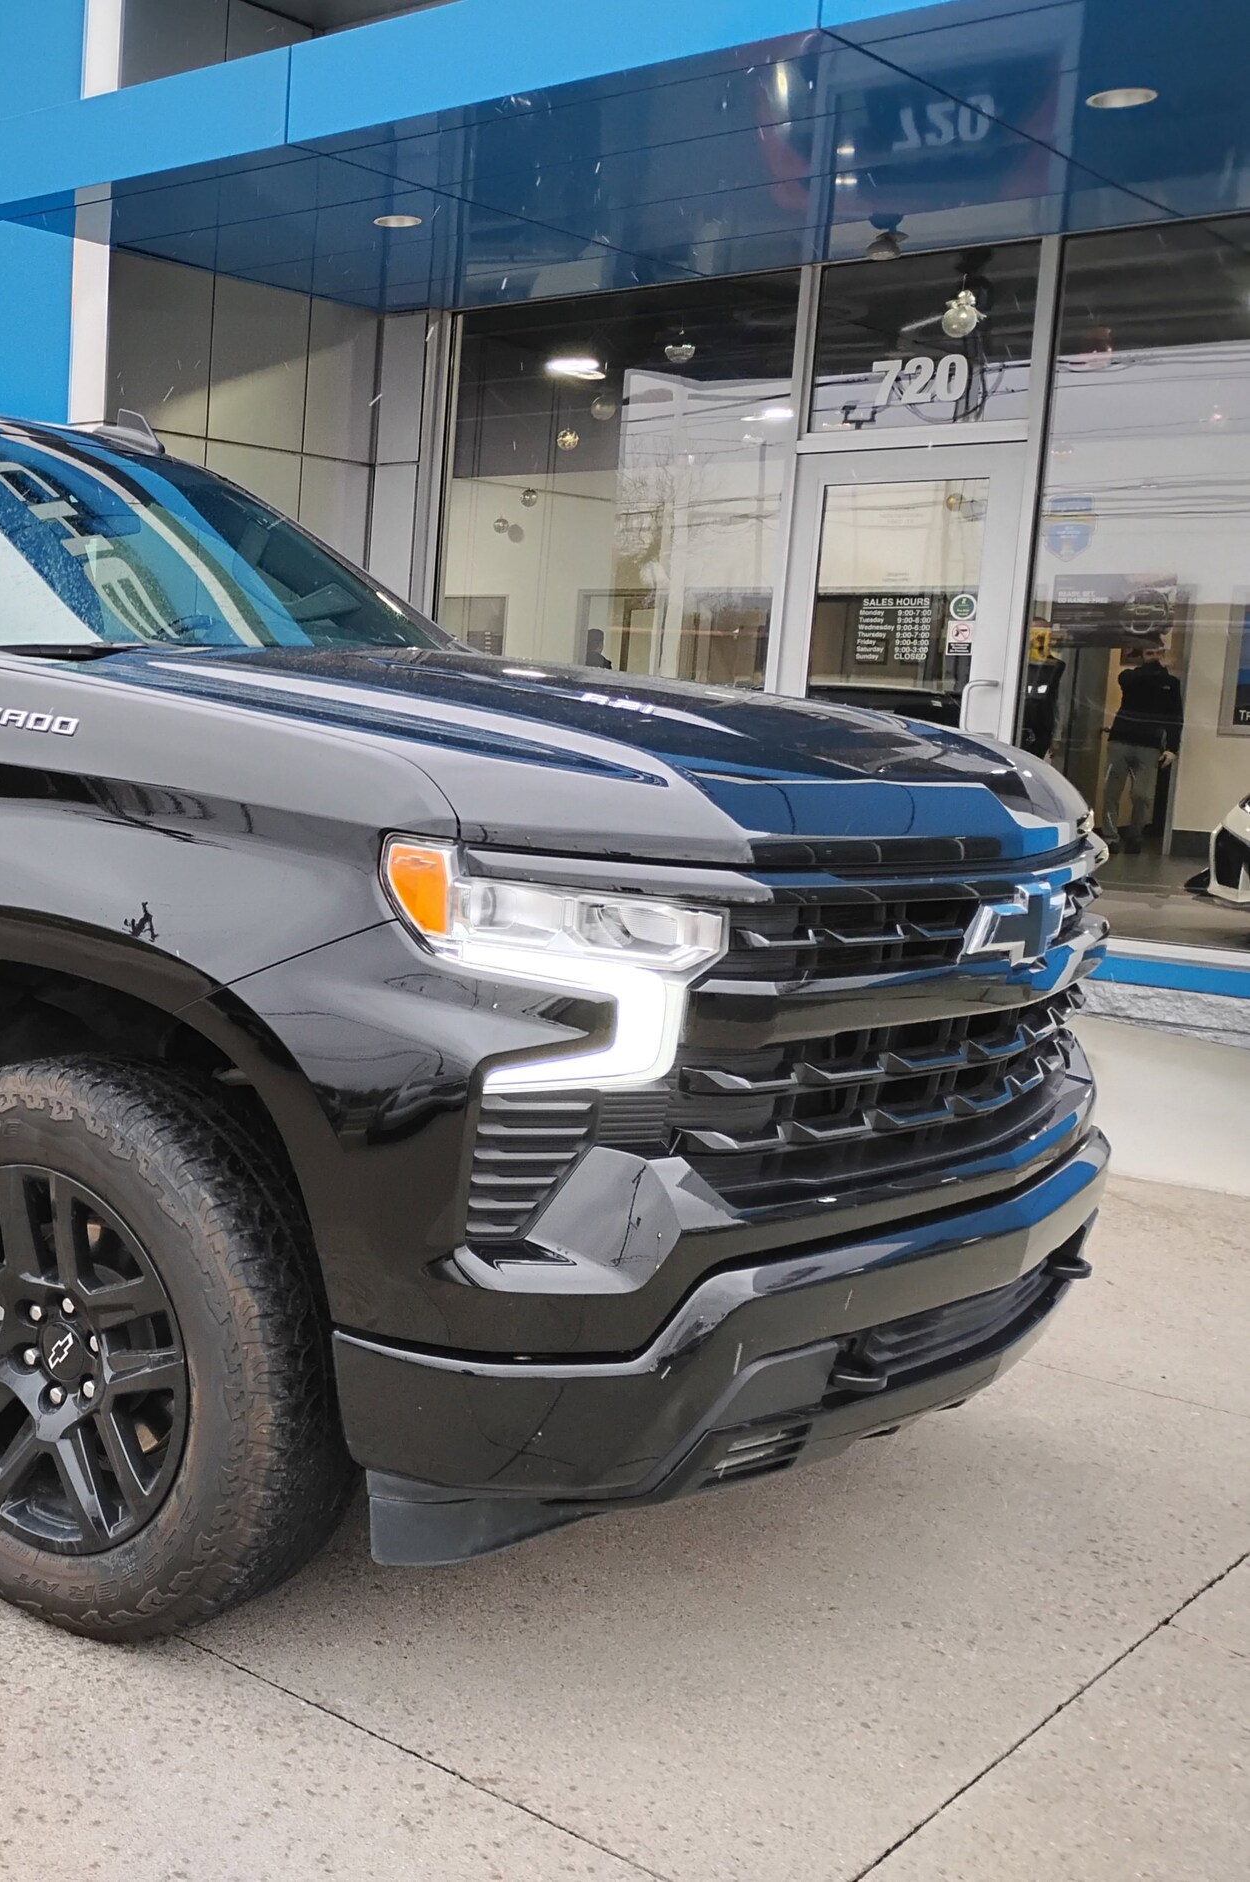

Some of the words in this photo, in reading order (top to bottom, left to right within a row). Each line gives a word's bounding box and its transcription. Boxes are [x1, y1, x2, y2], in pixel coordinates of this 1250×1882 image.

[871, 353, 969, 406] 720
[863, 598, 894, 607] SALES
[896, 597, 930, 606] HOURS
[859, 609, 885, 617] Monday
[859, 616, 885, 624] Tuesday
[858, 624, 895, 632] Wednesday
[858, 631, 887, 639] Thursday
